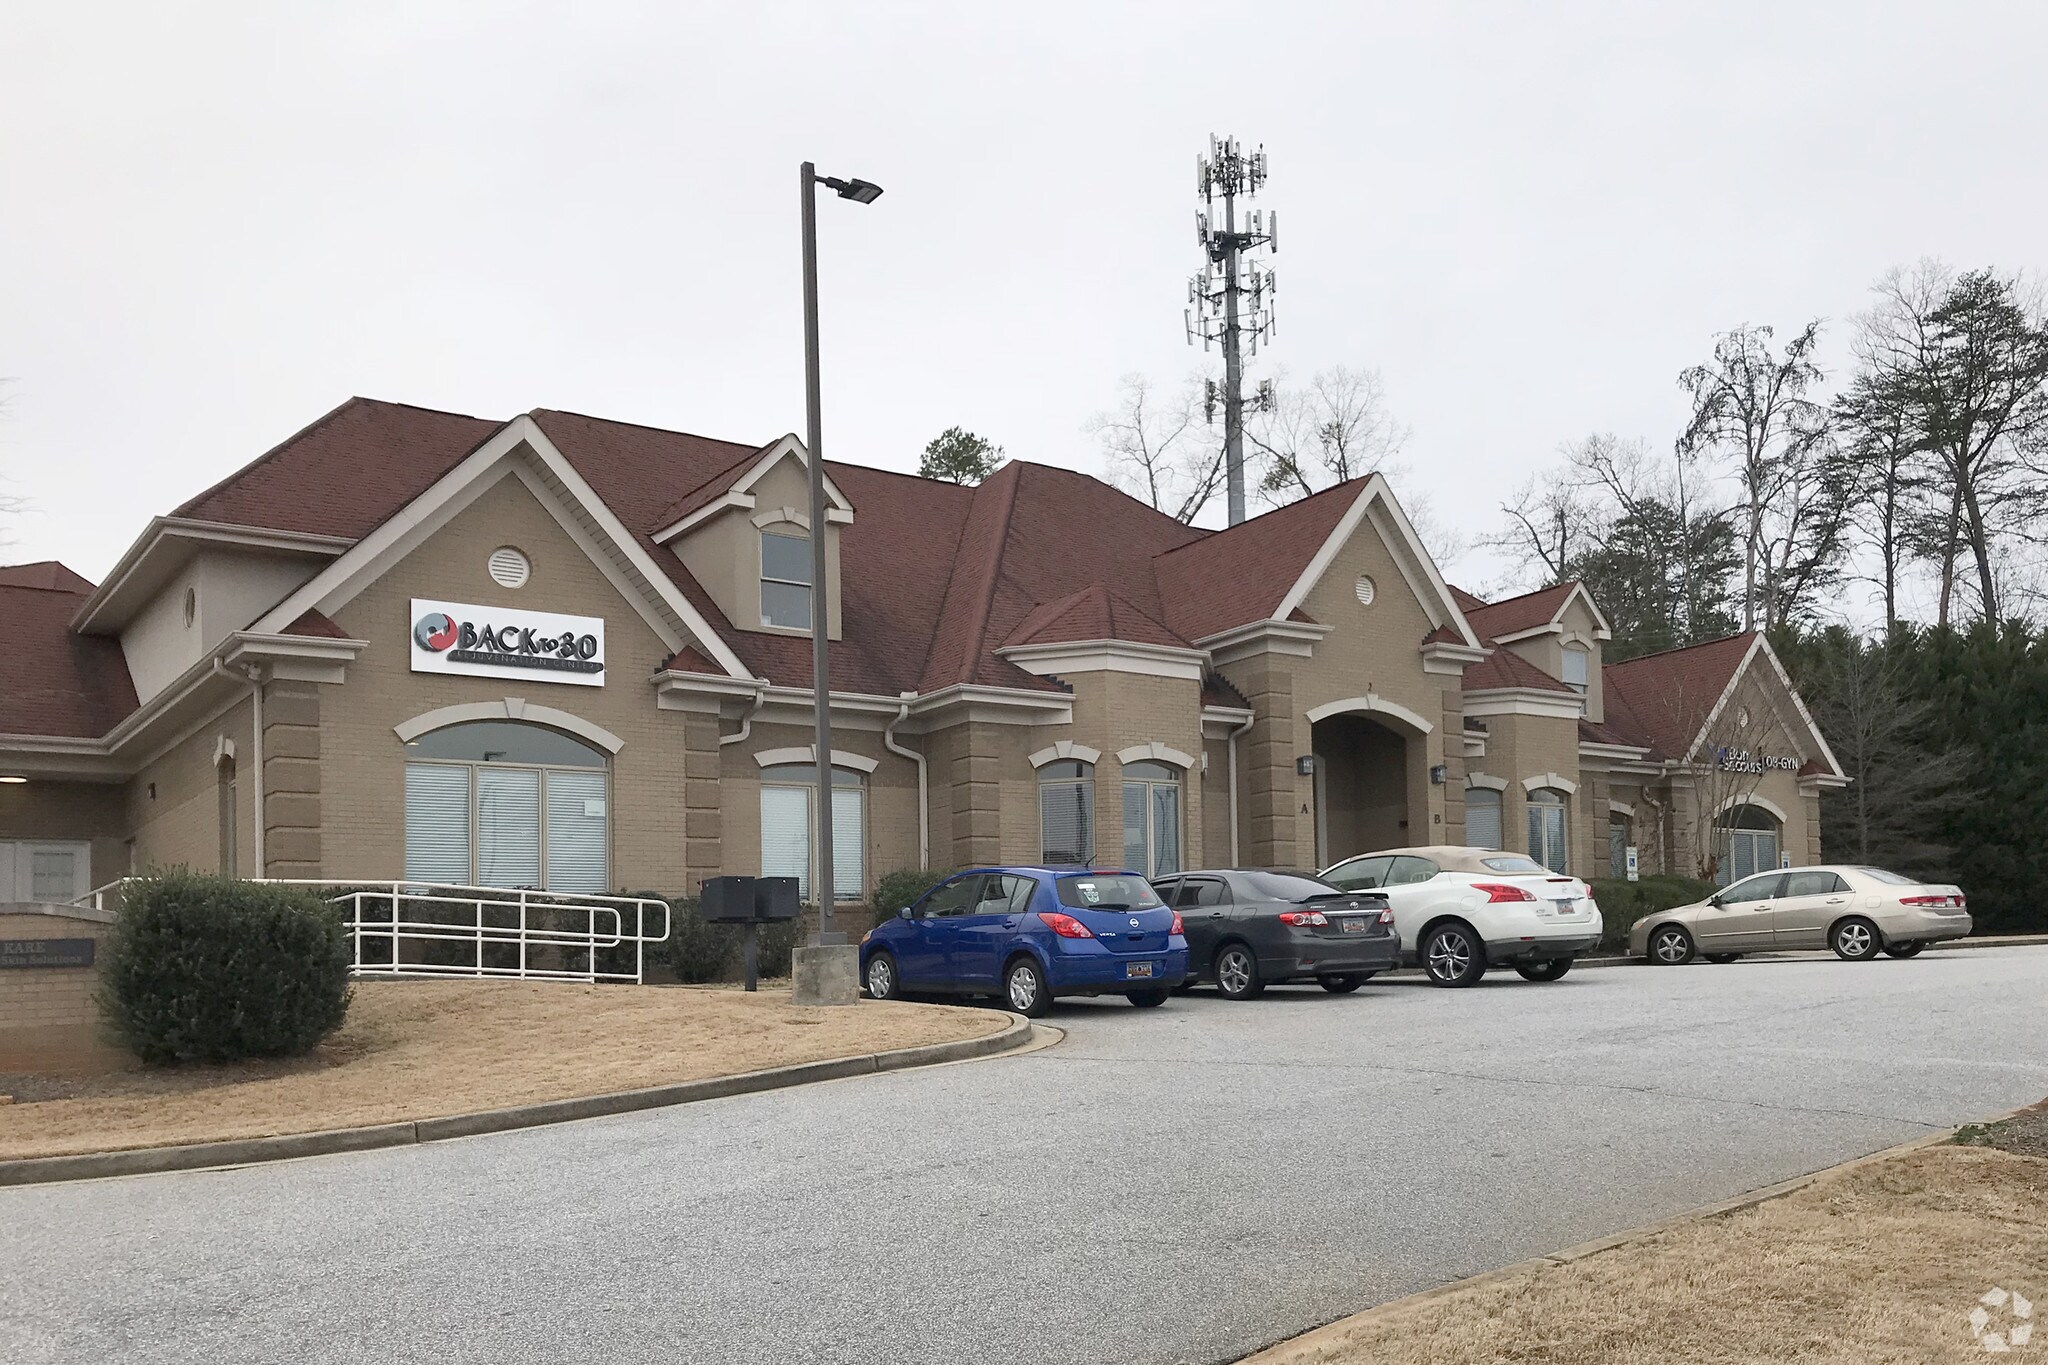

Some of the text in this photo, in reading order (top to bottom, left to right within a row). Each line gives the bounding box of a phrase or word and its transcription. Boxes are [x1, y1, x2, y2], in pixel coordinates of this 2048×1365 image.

[457, 621, 540, 656] BACK
[556, 631, 598, 661] 30
[1765, 755, 1799, 770] OB-GYN
[1300, 803, 1308, 814] A
[1434, 814, 1441, 824] B
